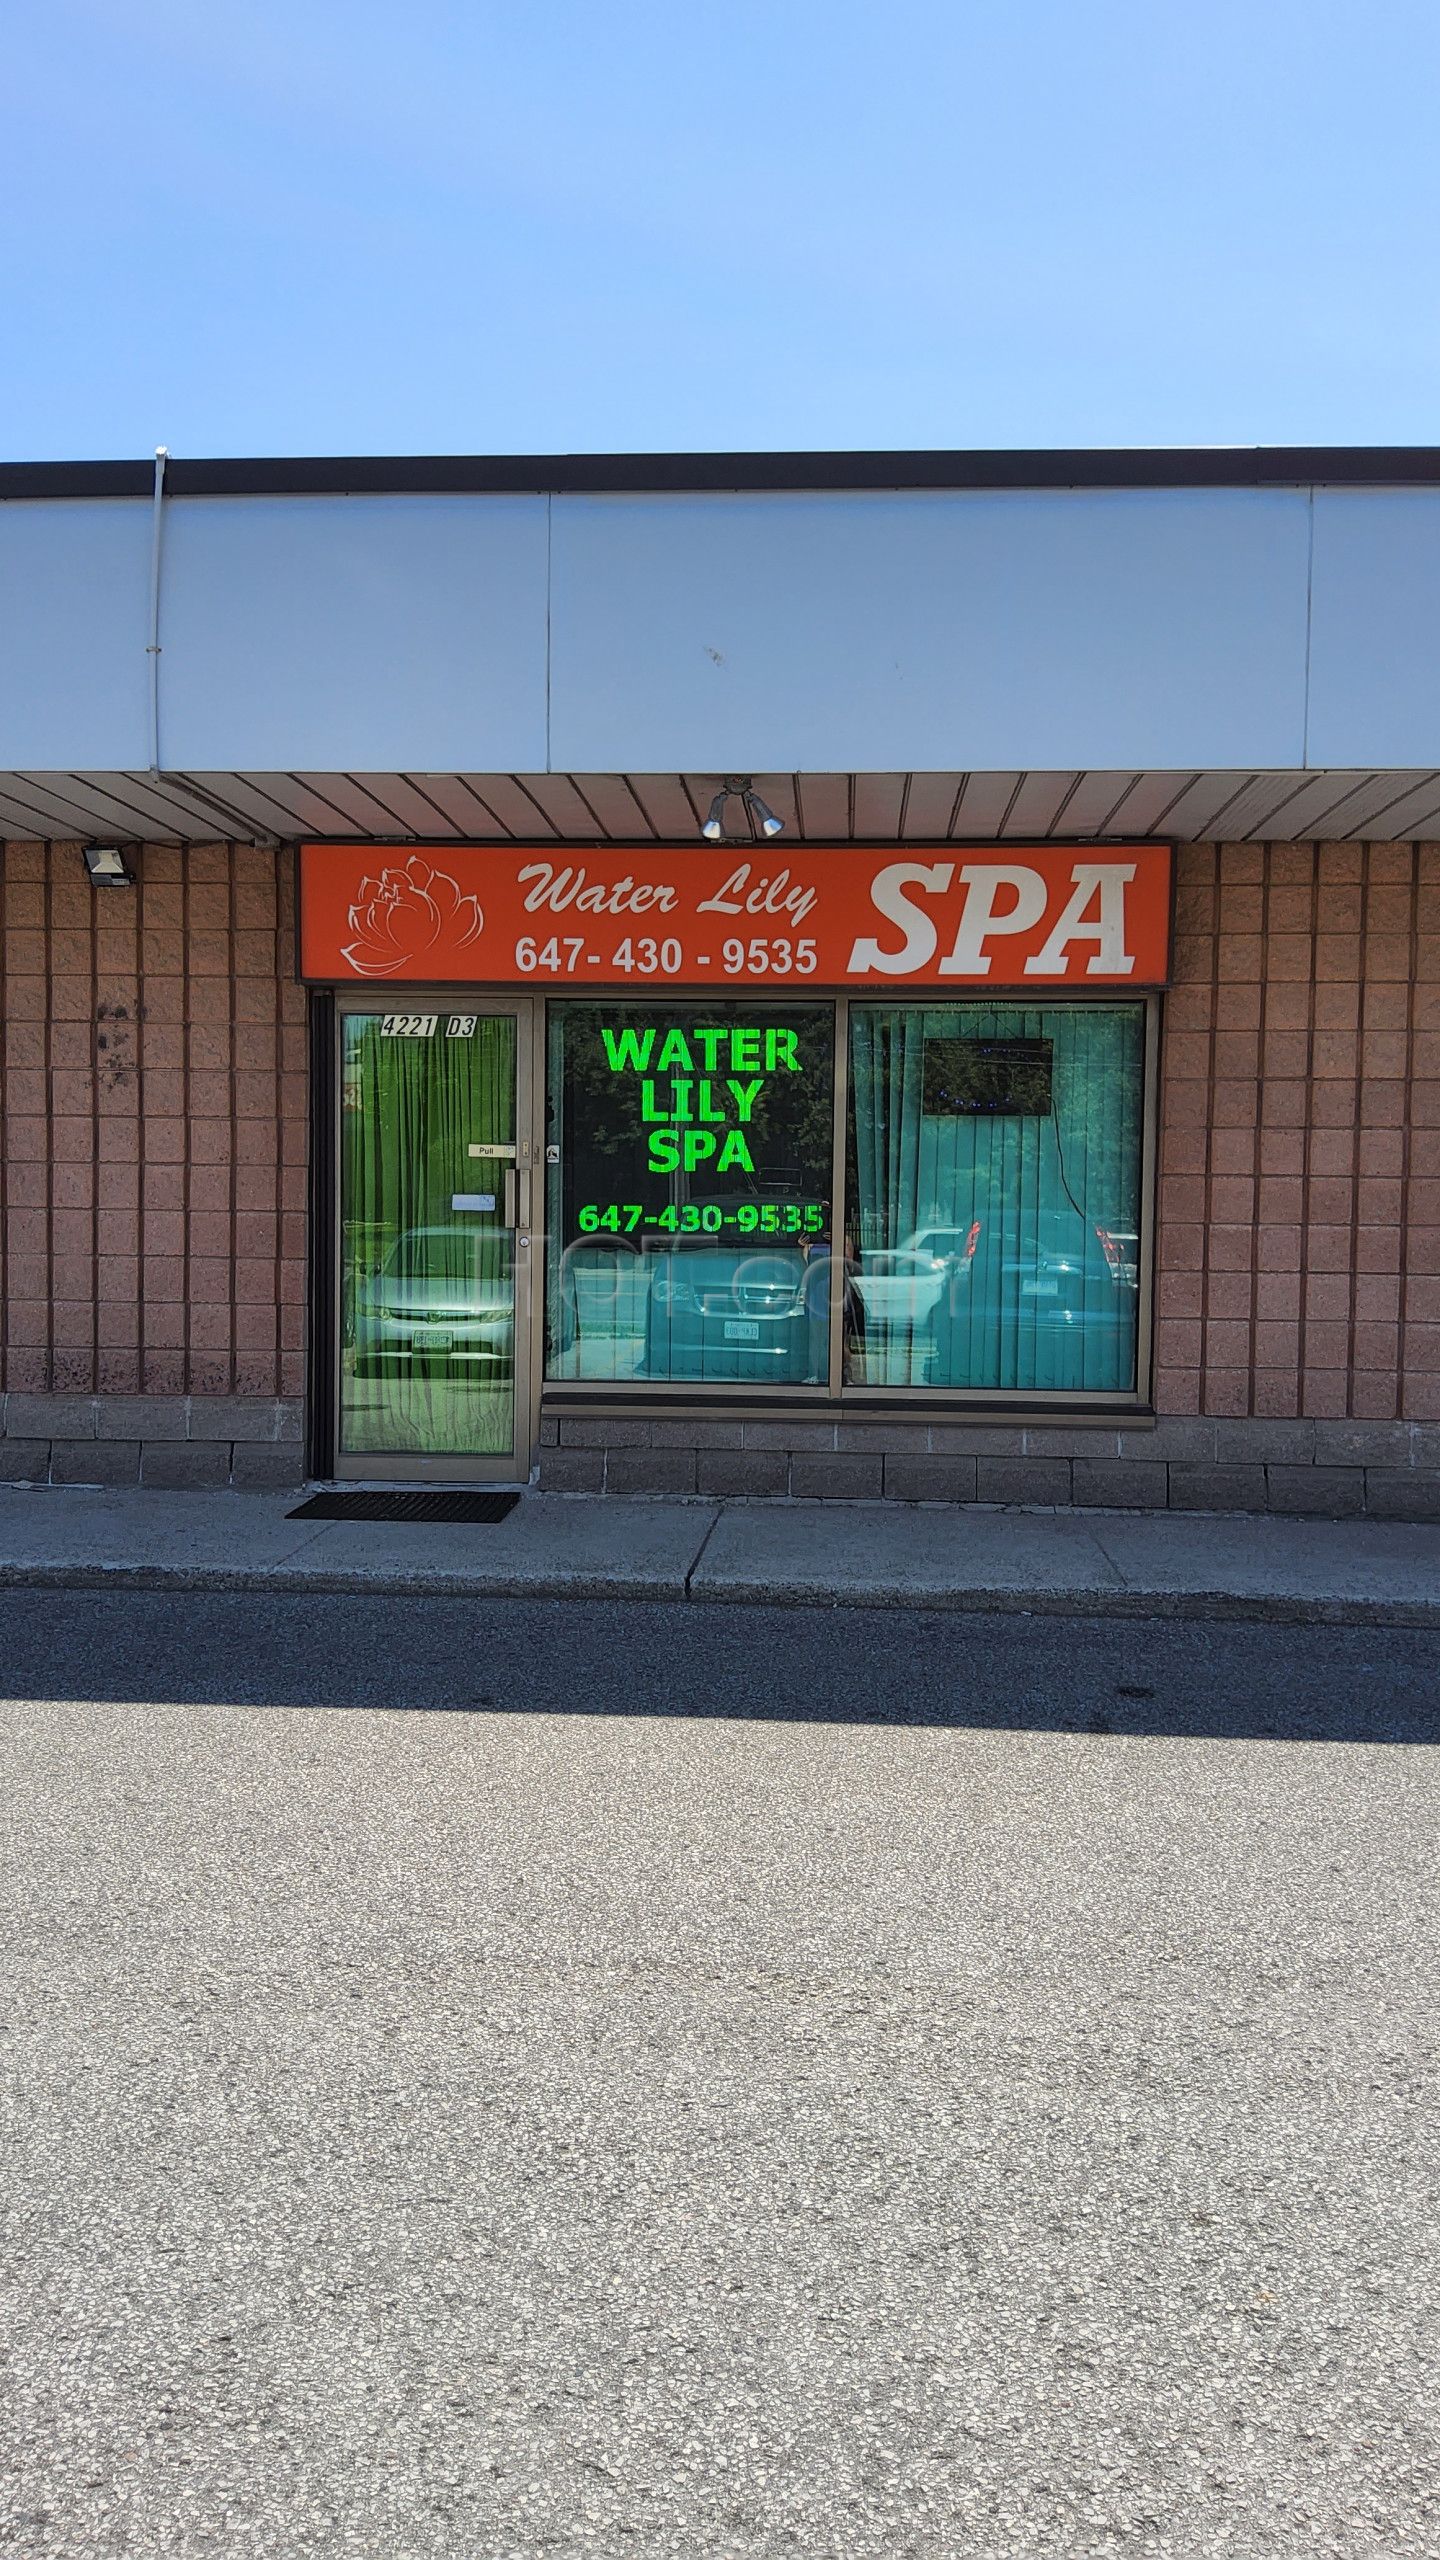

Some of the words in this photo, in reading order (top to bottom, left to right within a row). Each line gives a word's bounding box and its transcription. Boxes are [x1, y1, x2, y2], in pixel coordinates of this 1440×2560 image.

[516, 864, 678, 914] Water
[696, 863, 818, 928] Lily
[847, 862, 1137, 975] SPA
[383, 1016, 433, 1035] 4221
[448, 1017, 475, 1036] D3
[601, 1028, 803, 1072] WATER
[642, 1079, 765, 1122] LILY
[479, 1147, 494, 1155] Pull
[648, 1129, 755, 1173] SPA
[579, 1204, 824, 1233] 647-430-9535
